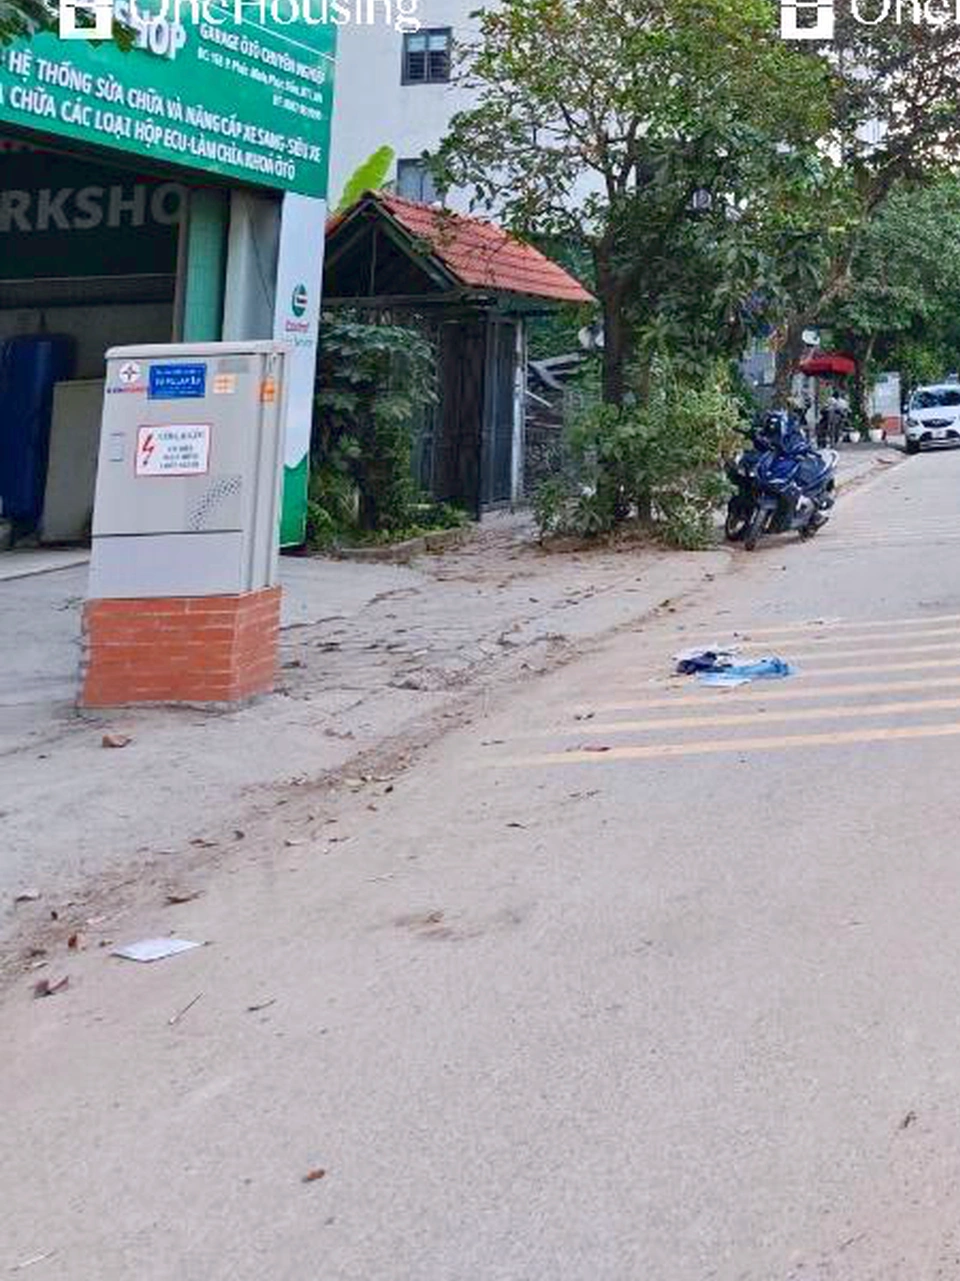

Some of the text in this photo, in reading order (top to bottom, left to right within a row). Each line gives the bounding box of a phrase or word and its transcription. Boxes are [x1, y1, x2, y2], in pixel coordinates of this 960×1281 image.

[9, 48, 33, 83] HỆ
[36, 57, 93, 95] THỐNG
[95, 73, 125, 105] SỬA
[126, 87, 165, 117] CHỮA
[166, 95, 183, 121] VÀ
[10, 85, 57, 118] CHỮA
[61, 96, 93, 127] CÁC
[94, 109, 132, 140] LOẠI
[134, 117, 163, 149] HỘP
